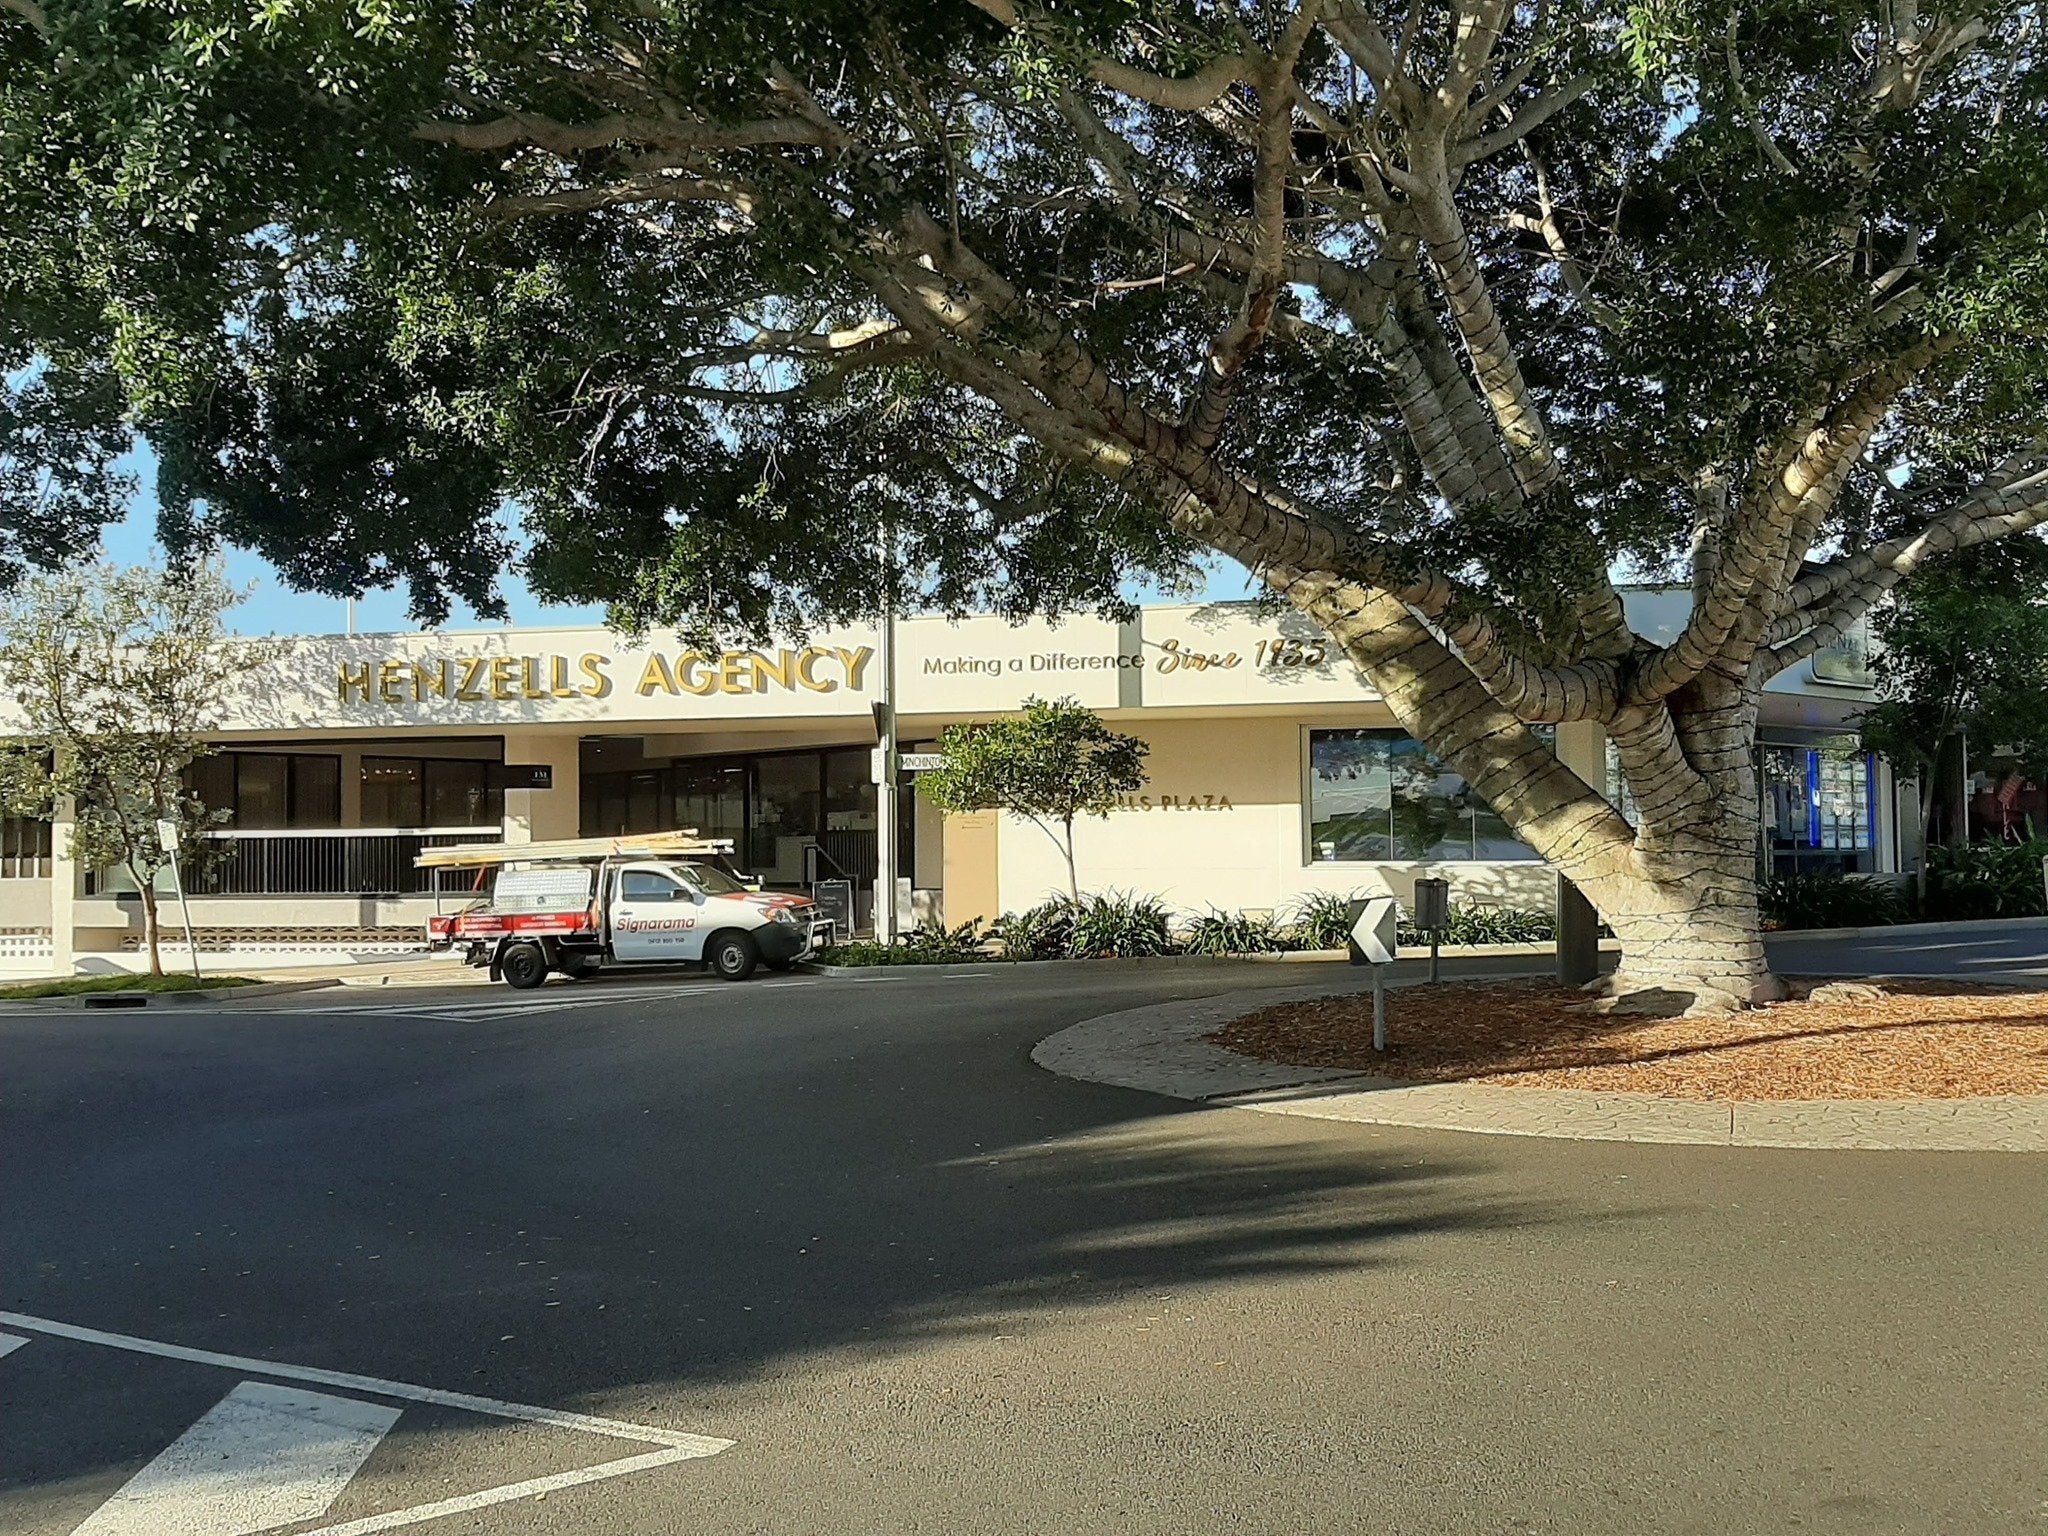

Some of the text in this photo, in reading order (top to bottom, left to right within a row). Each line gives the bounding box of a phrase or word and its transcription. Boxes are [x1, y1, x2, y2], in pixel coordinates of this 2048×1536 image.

[924, 653, 1145, 677] Making a Difference
[1156, 638, 1326, 674] Since 1935
[337, 647, 874, 703] HENZELLS AGENCY
[1161, 794, 1233, 811] PLAZA
[617, 918, 695, 933] Signarama
